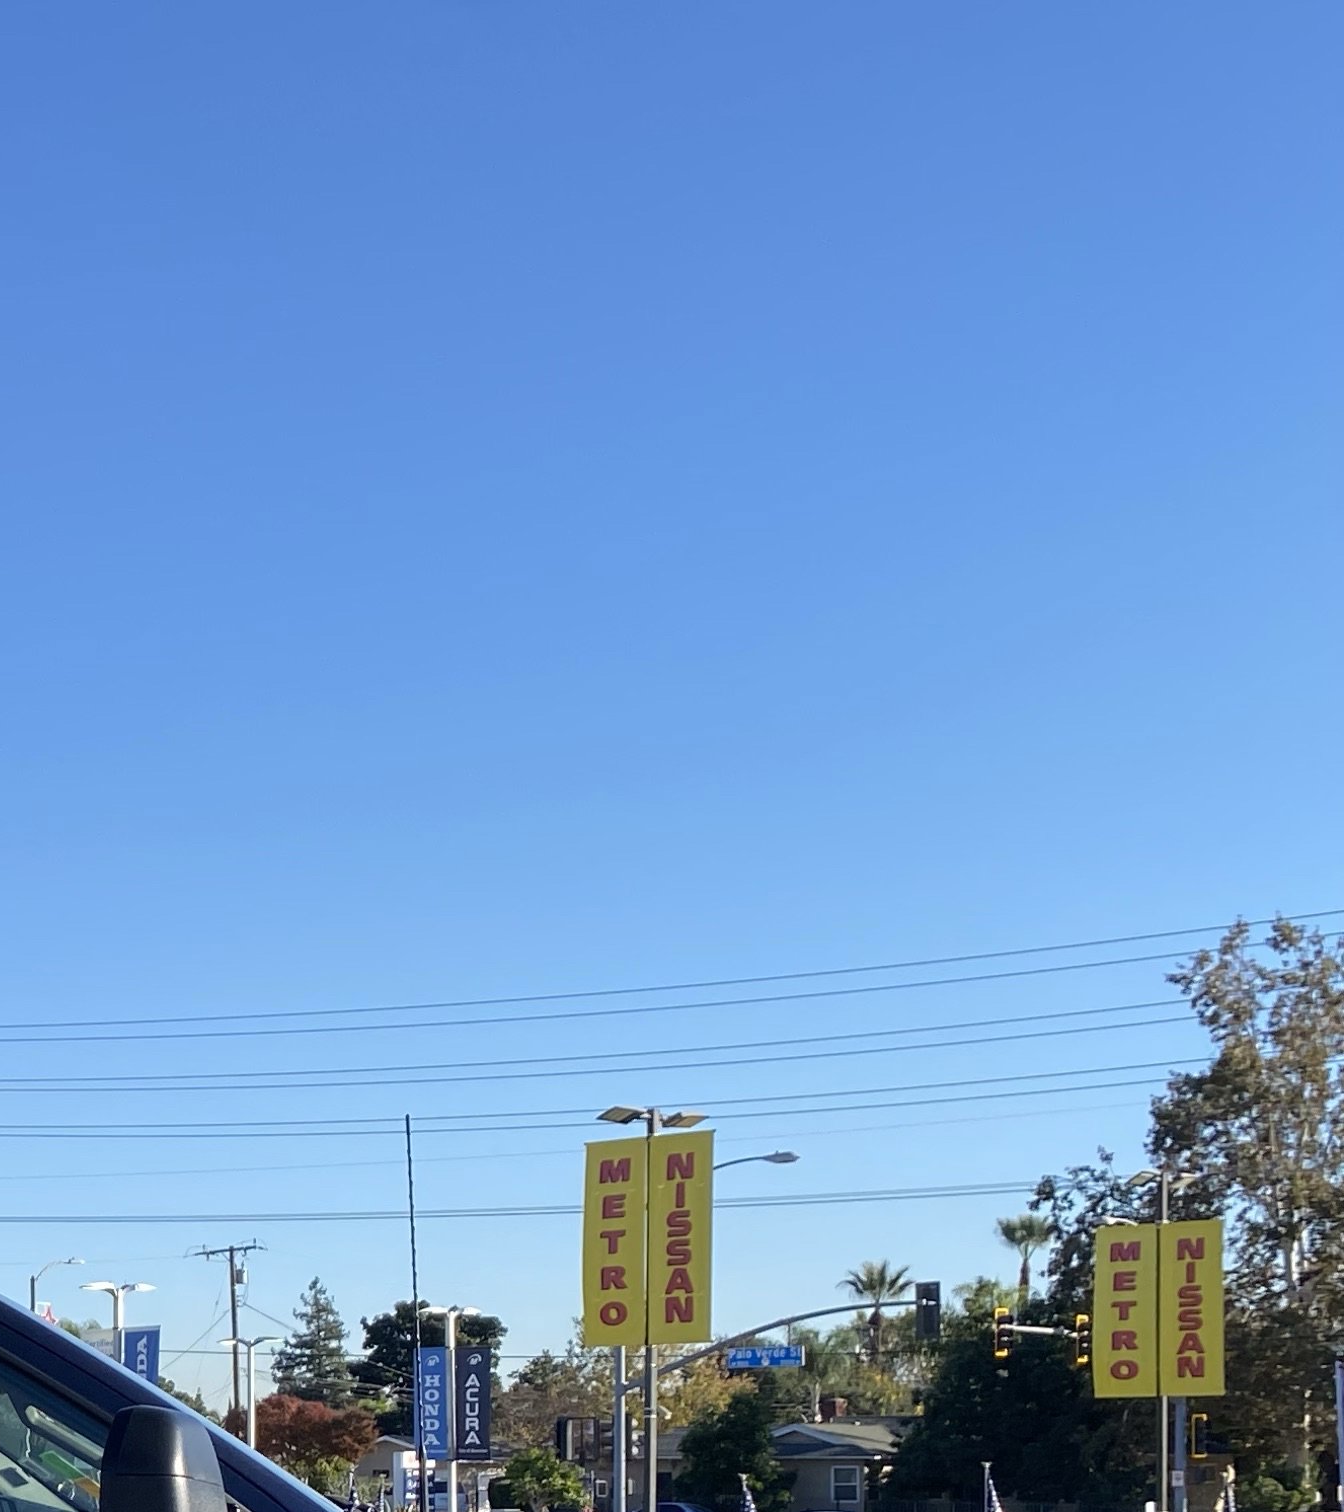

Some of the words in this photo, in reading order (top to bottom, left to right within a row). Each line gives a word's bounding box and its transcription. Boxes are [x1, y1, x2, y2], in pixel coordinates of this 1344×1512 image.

[599, 1158, 631, 1326] METRO
[665, 1152, 695, 1323] NISSAN
[729, 1348, 752, 1359] Palo
[756, 1347, 786, 1358] Verde
[1110, 1241, 1141, 1380] METRO
[1176, 1237, 1205, 1378] NISSAN
[424, 1374, 440, 1445] HONDA
[465, 1373, 480, 1445] ACURA
